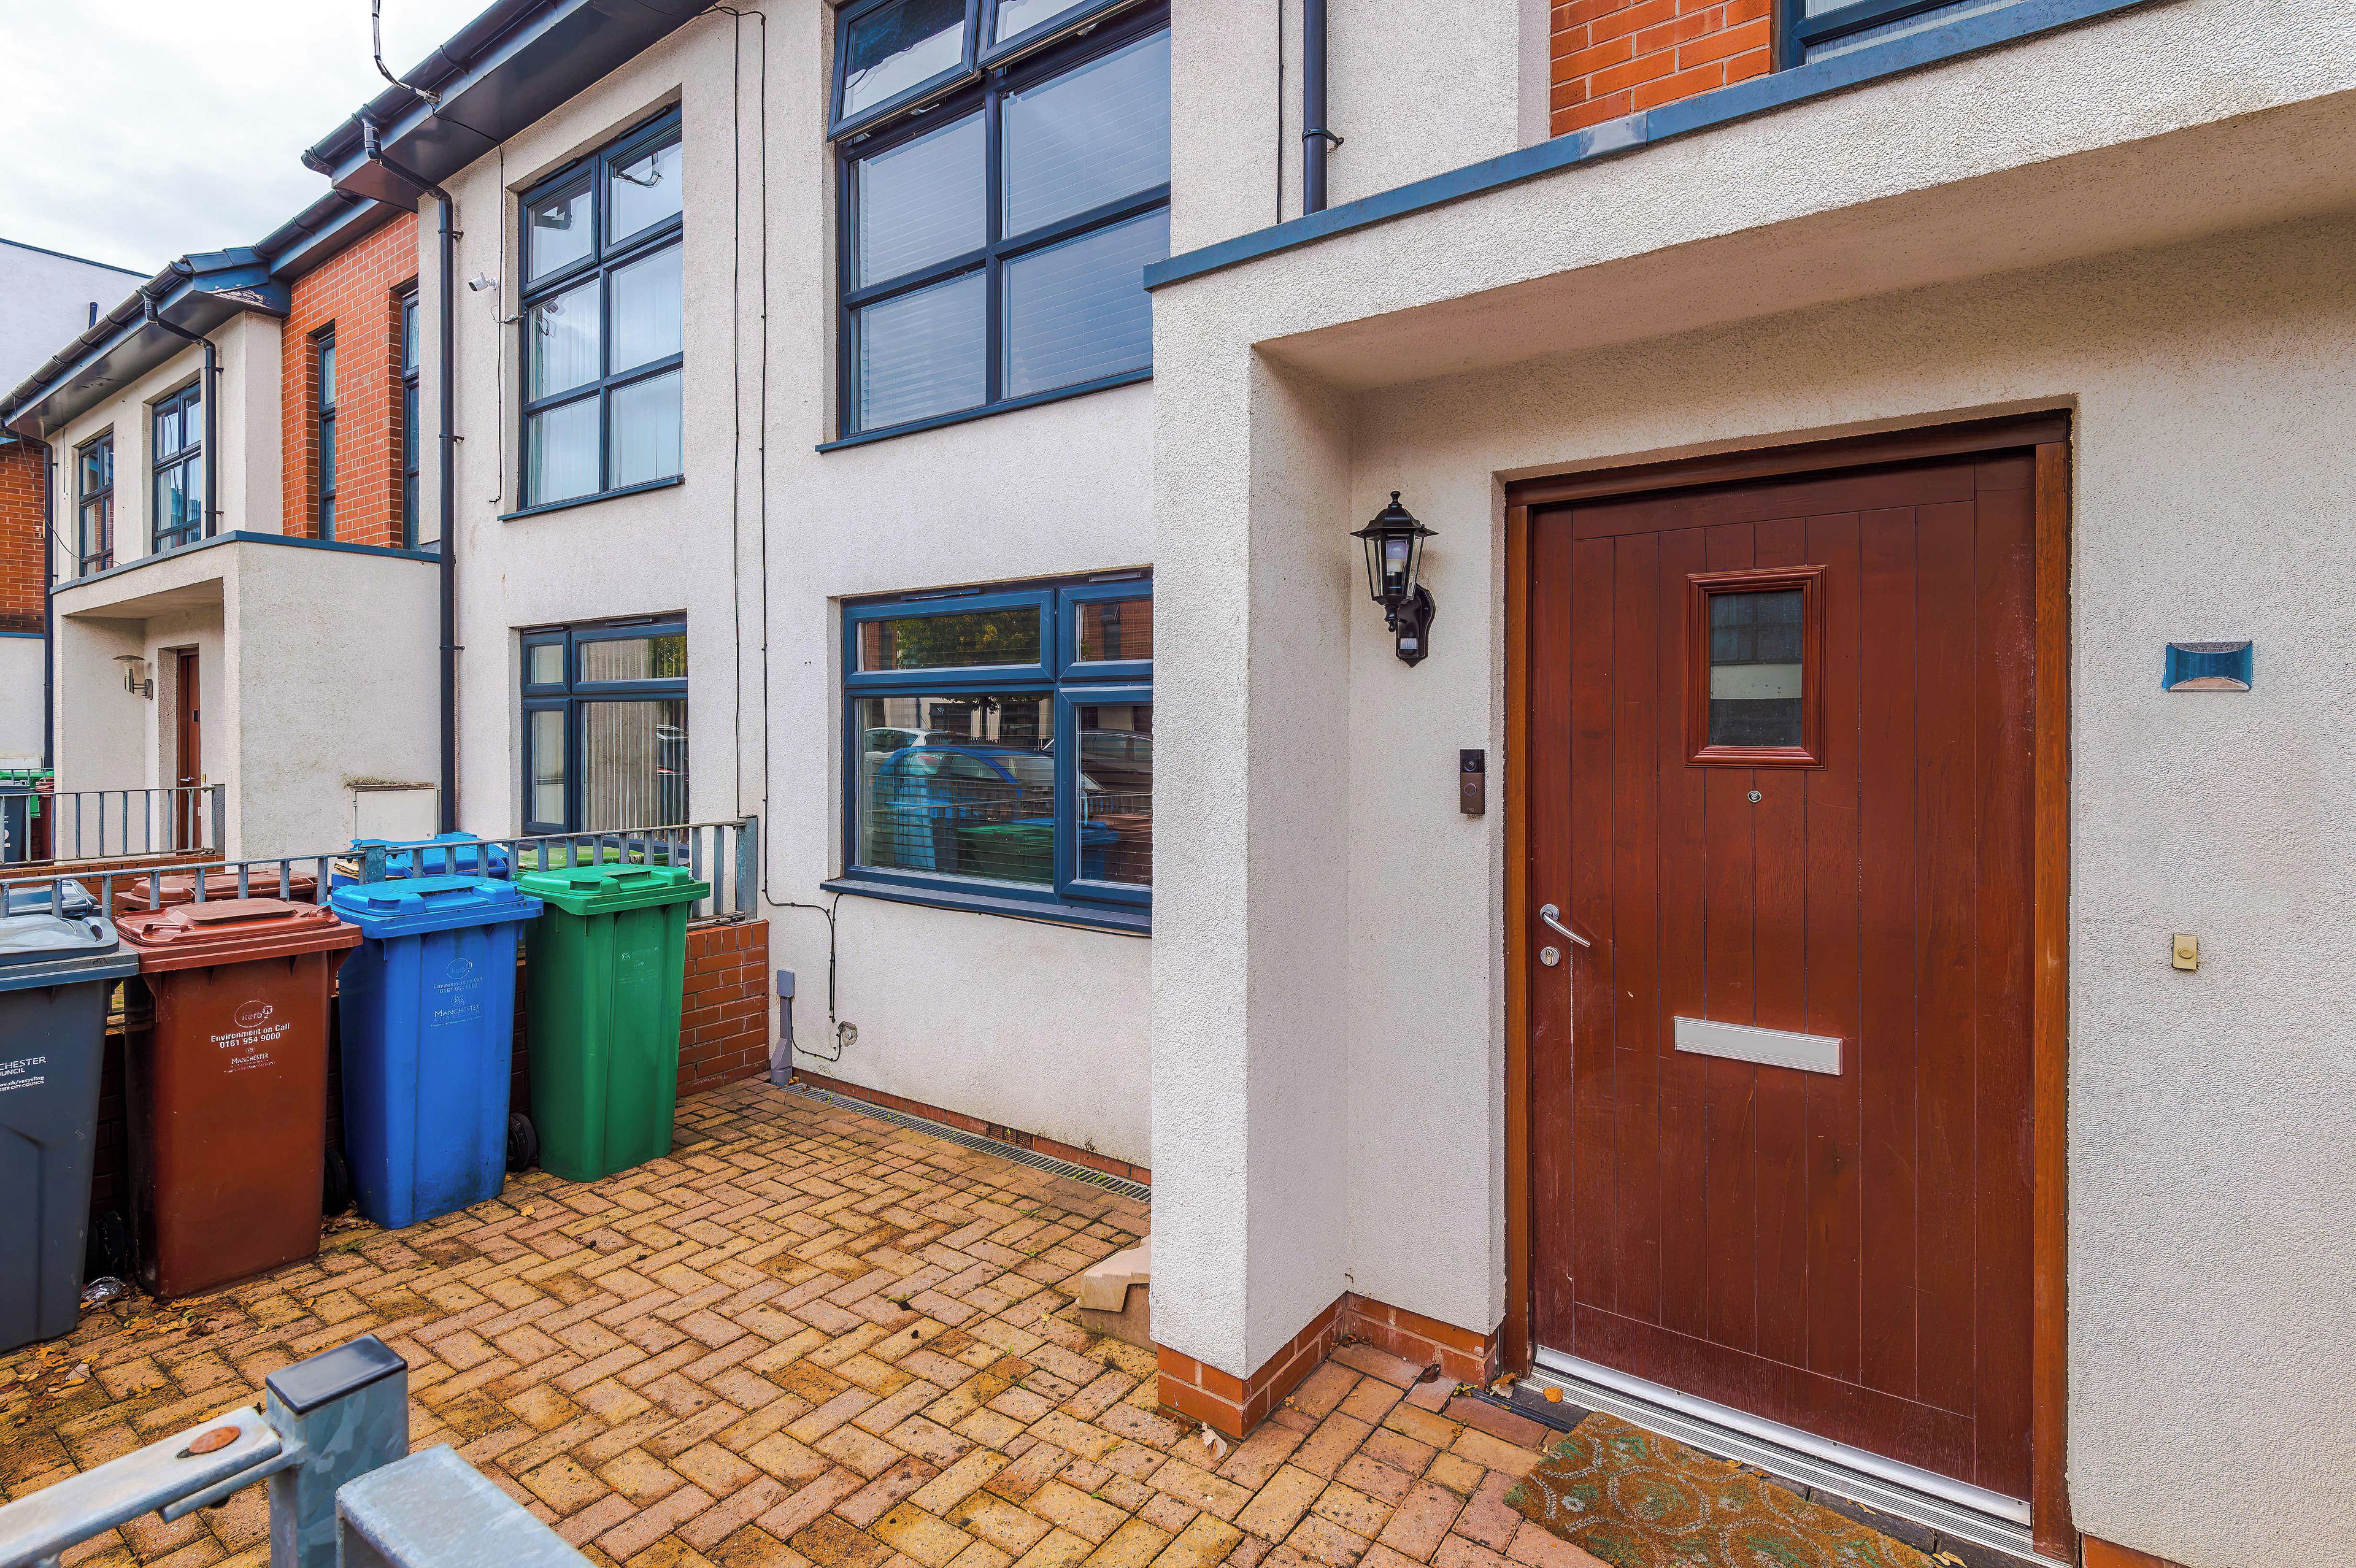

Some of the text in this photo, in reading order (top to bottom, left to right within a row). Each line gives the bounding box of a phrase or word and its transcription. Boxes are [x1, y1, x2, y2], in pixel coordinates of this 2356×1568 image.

[210, 1028, 261, 1042] Environment
[275, 1023, 290, 1031] Call
[220, 1032, 280, 1048] 0161 954 9000
[0, 1067, 25, 1077] UNCIL
